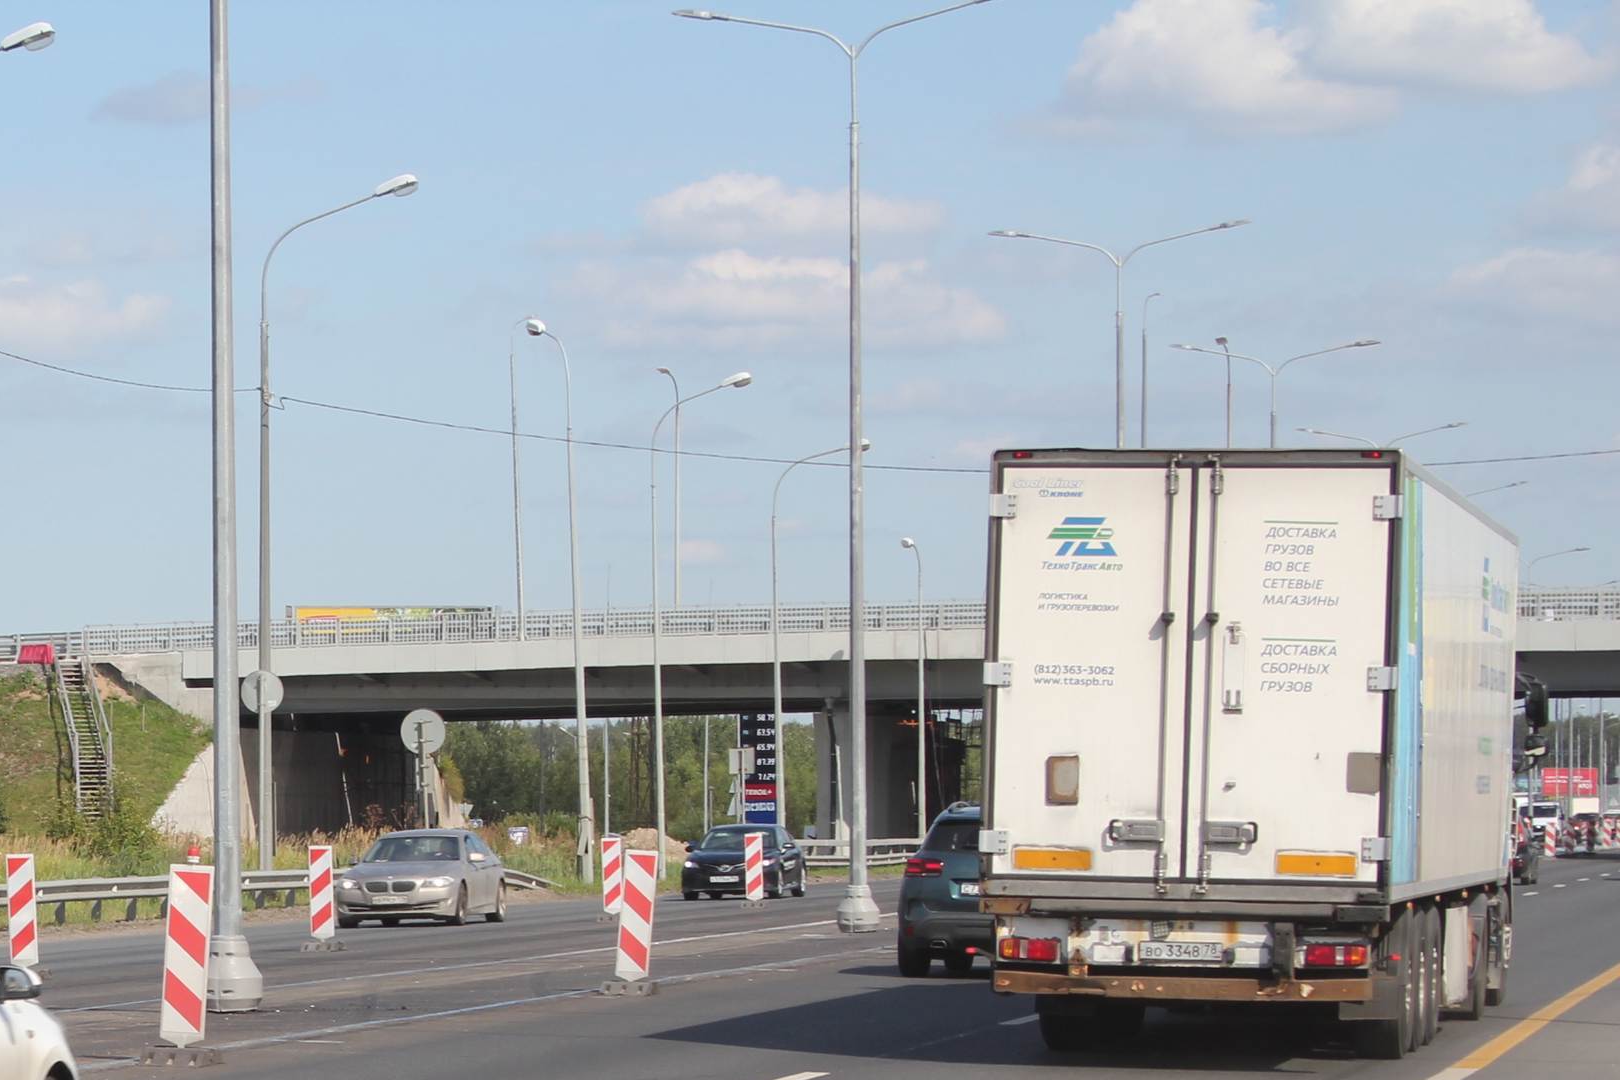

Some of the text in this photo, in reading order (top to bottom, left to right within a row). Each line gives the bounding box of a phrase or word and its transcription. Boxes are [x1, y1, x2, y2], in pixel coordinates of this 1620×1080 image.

[1265, 527, 1337, 539] ДОСТАВКА
[1264, 544, 1314, 555] ГРУЗОВ
[1264, 561, 1311, 572] ВО ВСЕ
[1262, 578, 1324, 590] СЕТЕВЫЕ
[1262, 595, 1339, 607] МАГАЗИНЫ
[1047, 603, 1119, 611] ГРУЗОПЕРЕВОЗКИ
[1261, 644, 1337, 657] ДОСТАВКА
[1261, 663, 1330, 675] СБОРНЫХ
[1034, 677, 1114, 687] www.ttaspb.ru
[1260, 681, 1312, 692] ГРУЗОВ
